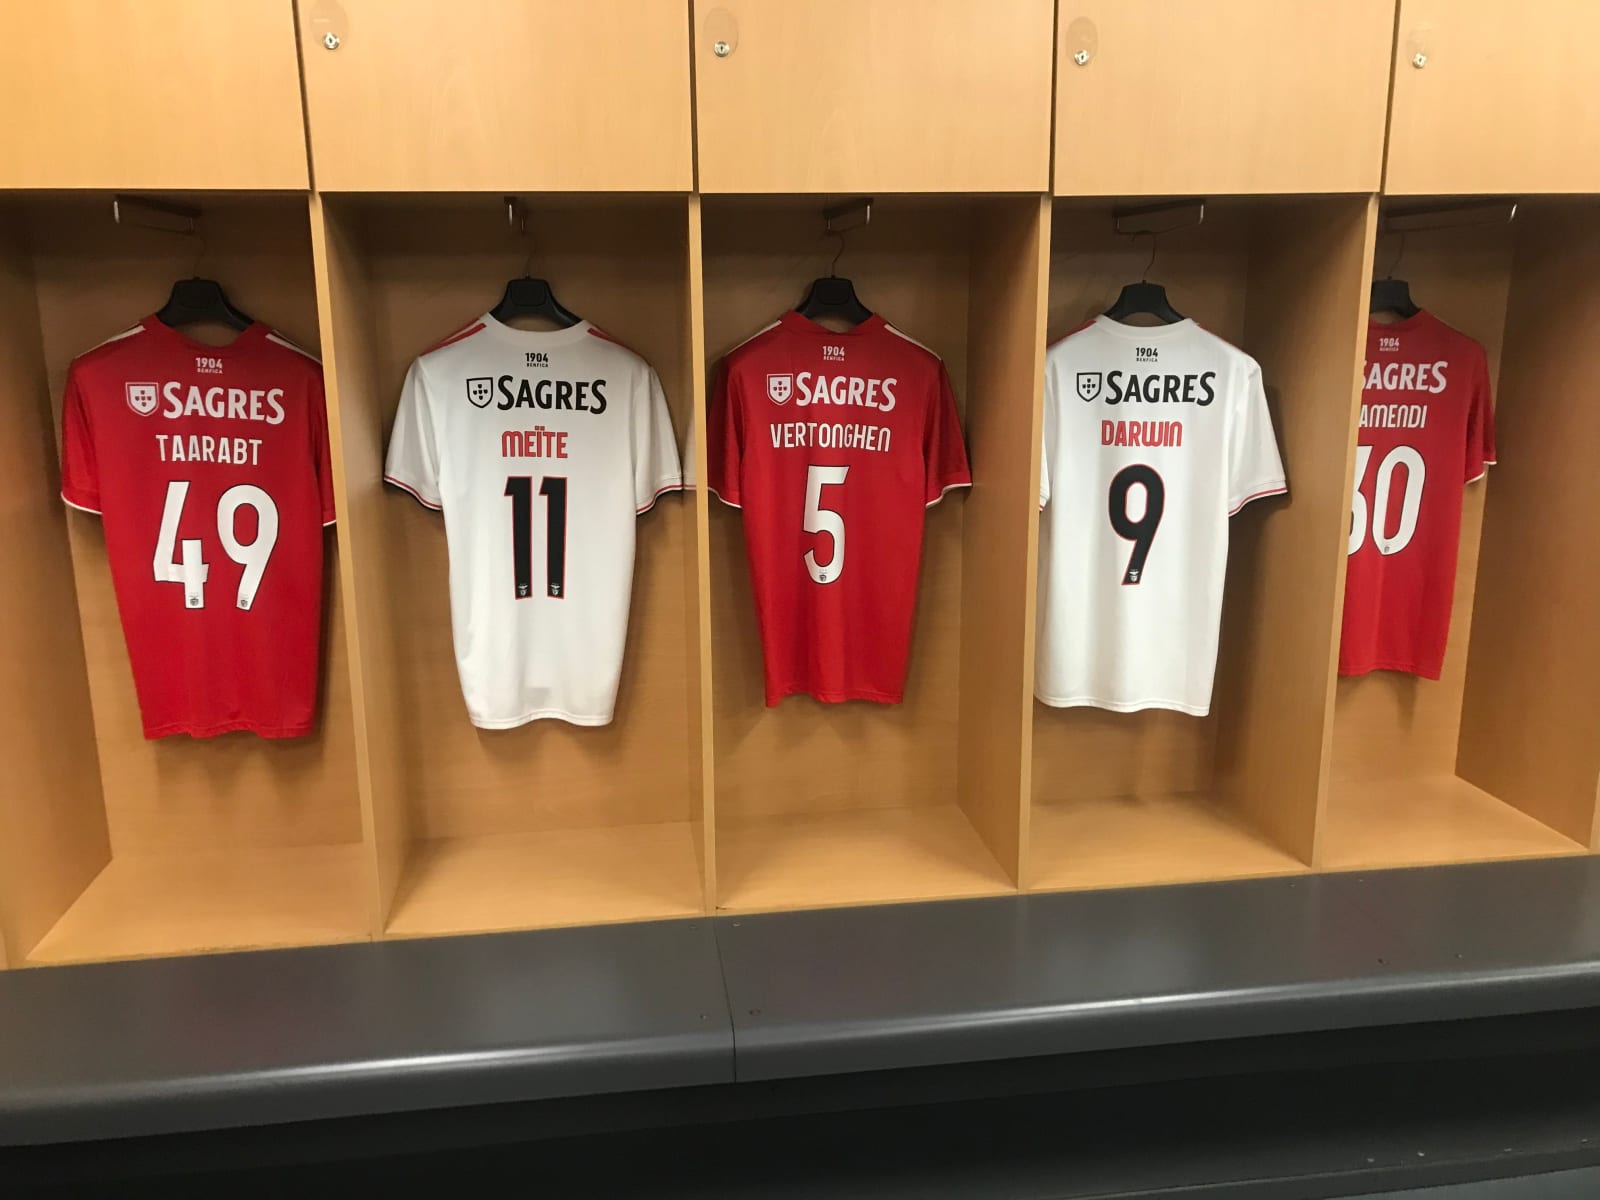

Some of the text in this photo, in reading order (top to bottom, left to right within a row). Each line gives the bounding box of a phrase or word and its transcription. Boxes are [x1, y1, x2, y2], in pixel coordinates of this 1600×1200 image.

[525, 352, 549, 363] 1904
[822, 345, 845, 357] 1904
[1135, 347, 1158, 358] 1904
[1379, 337, 1399, 347] 1904
[195, 357, 223, 369] 1904
[163, 381, 285, 425] SAGRES
[497, 375, 607, 414] SAGRES
[796, 371, 897, 412] SAGRES
[1105, 370, 1216, 407] SAGRES
[156, 434, 262, 465] TAARABT
[501, 425, 568, 458] MEÏTE
[770, 422, 891, 452] VERTONGHEN
[1101, 419, 1183, 447] DARWIN
[503, 475, 567, 600] 11
[802, 464, 850, 584] 5
[1108, 463, 1165, 586] 9
[153, 480, 279, 610] 49
